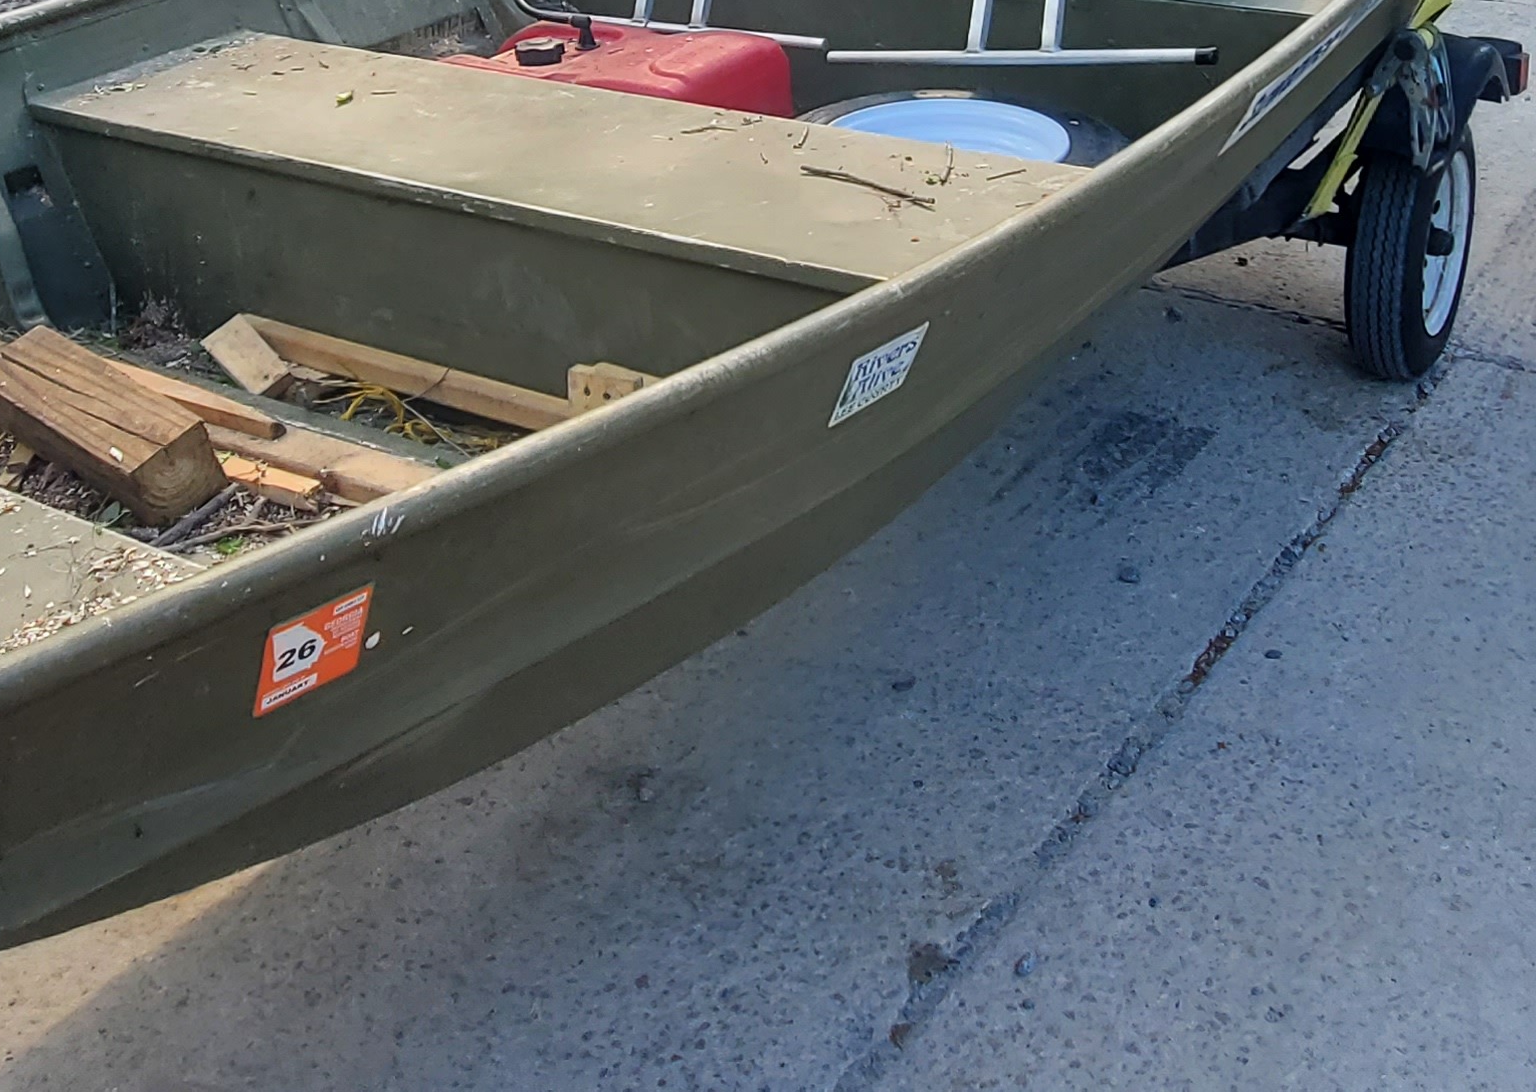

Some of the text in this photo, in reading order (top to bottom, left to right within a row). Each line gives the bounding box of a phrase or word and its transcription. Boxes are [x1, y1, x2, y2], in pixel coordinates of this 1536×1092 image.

[854, 336, 919, 381] Rivers
[275, 638, 317, 673] 26
[266, 679, 310, 705] JANUARY
